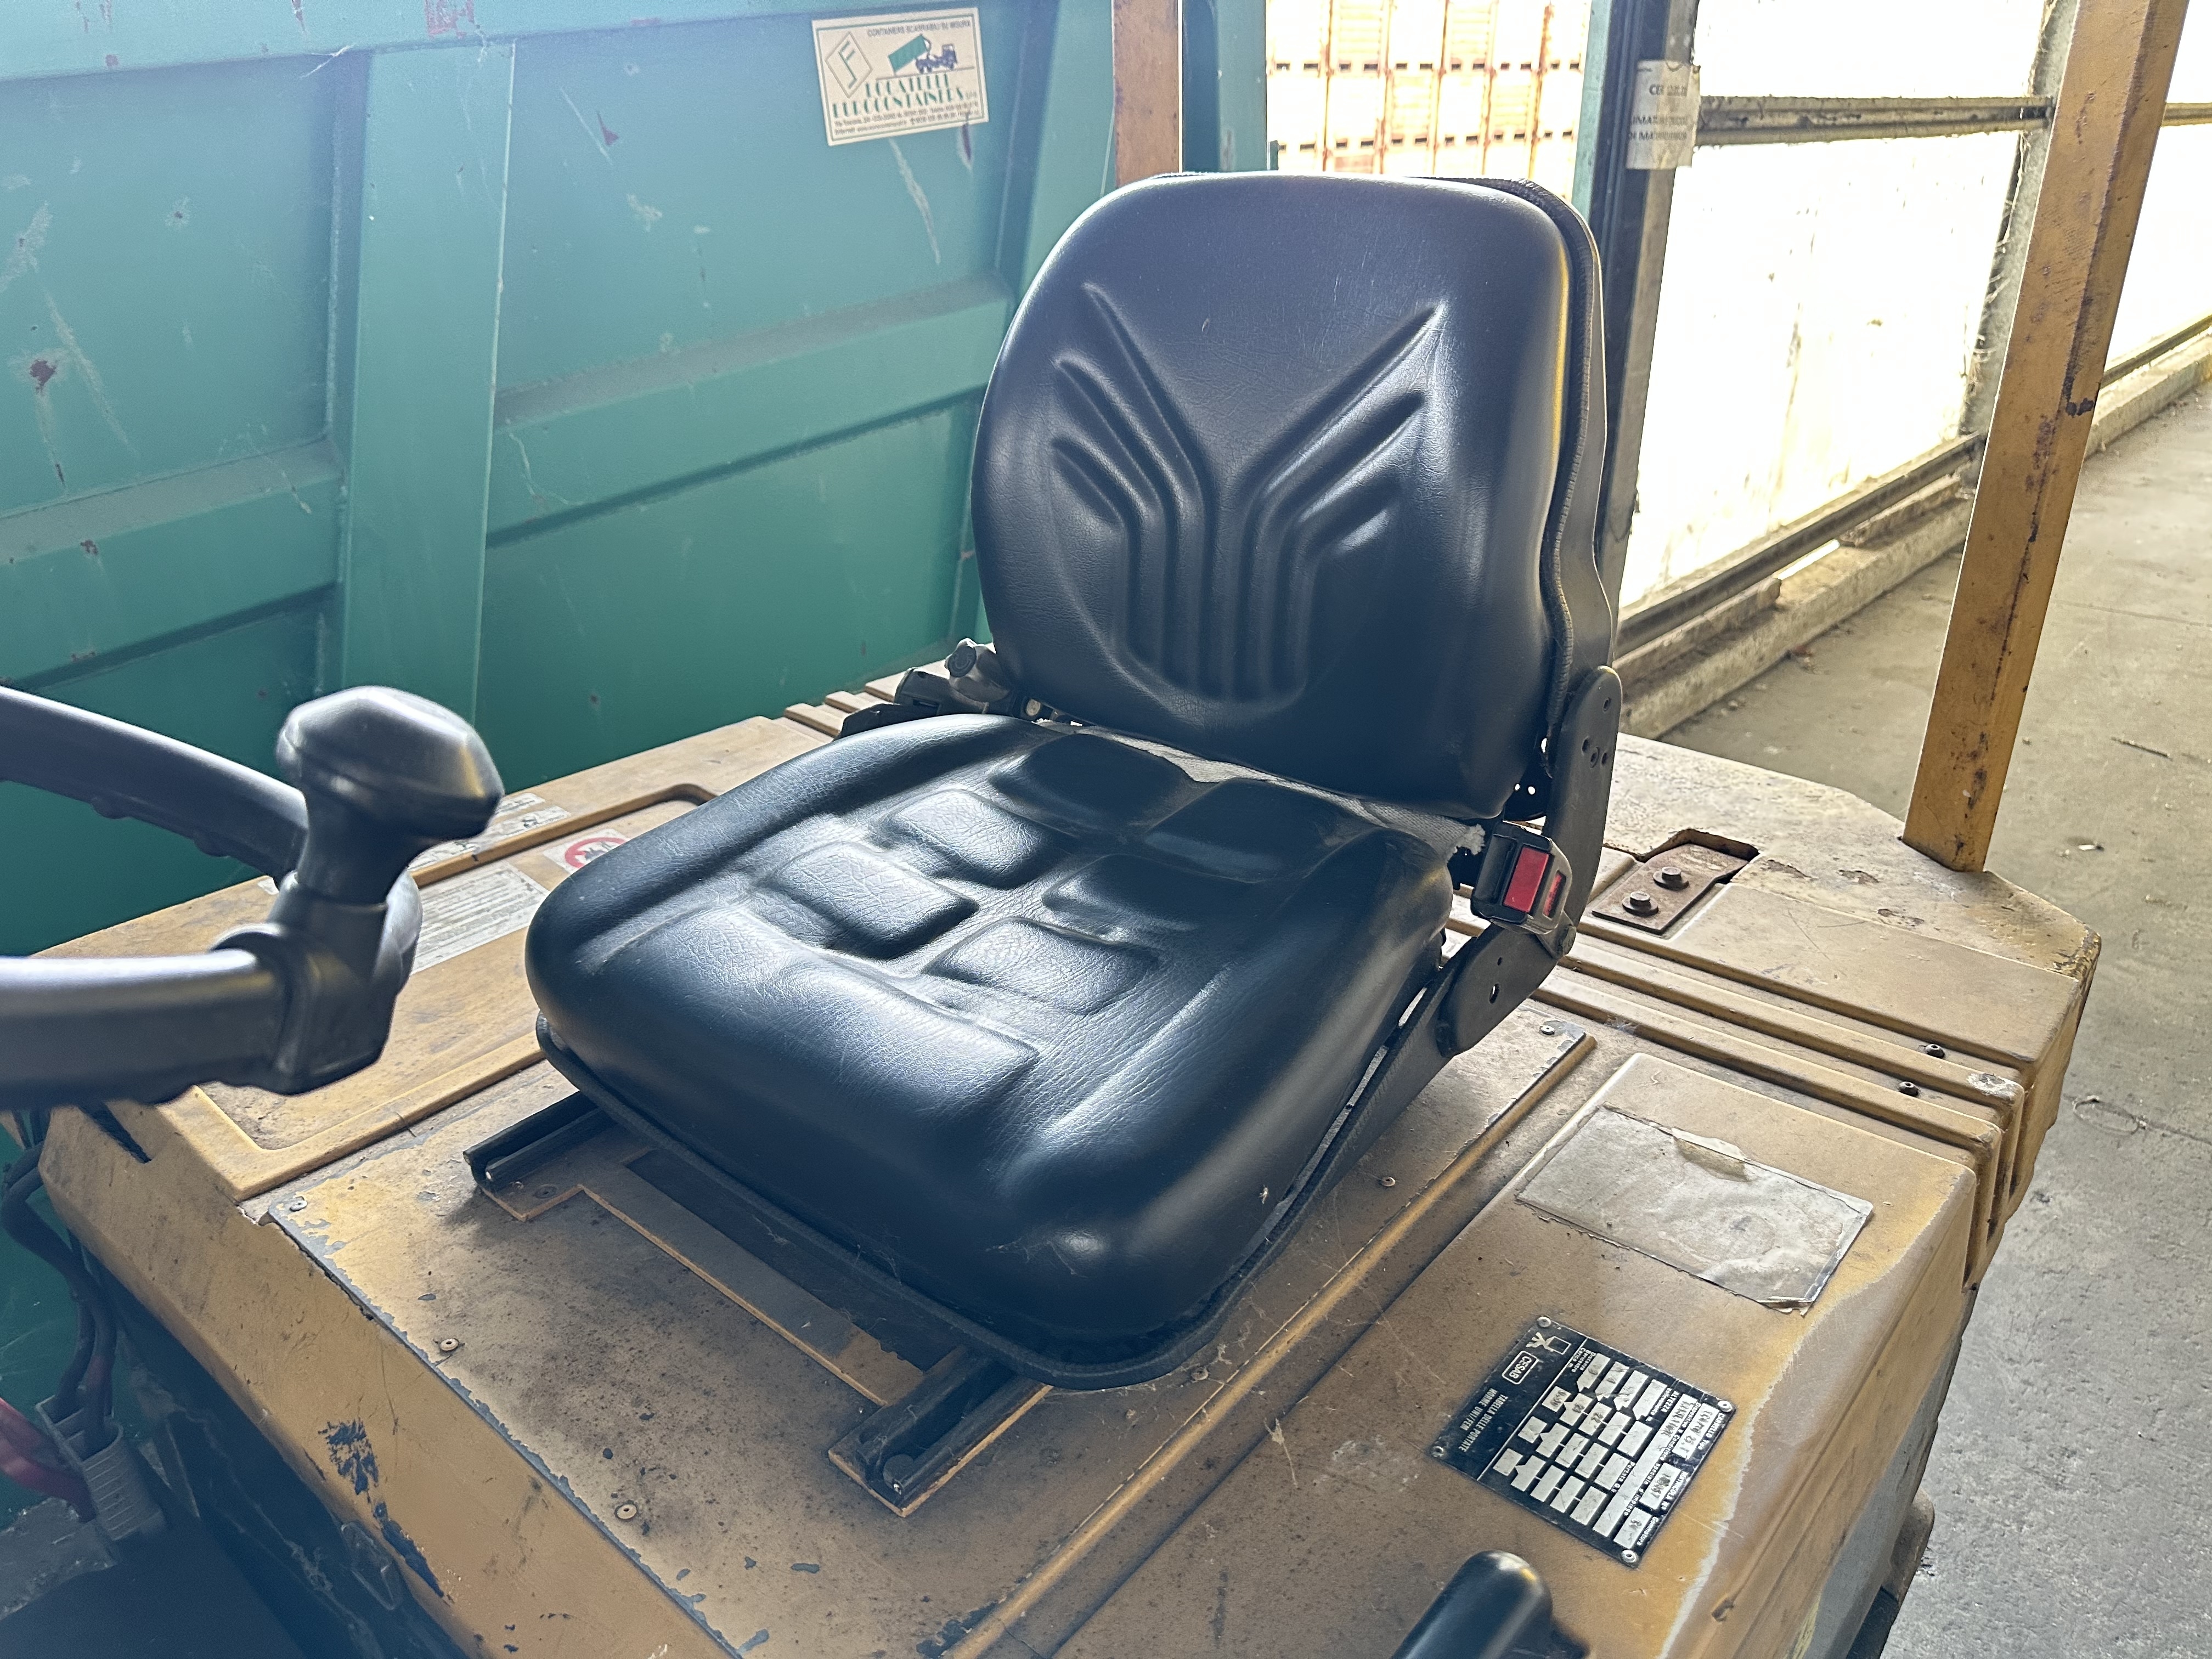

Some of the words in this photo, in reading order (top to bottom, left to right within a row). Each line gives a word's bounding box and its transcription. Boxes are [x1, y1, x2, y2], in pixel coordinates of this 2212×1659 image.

[1507, 1355, 1533, 1379] CESAB
[1570, 1349, 1591, 1373] Baricentro
[1578, 1351, 1596, 1371] Distanza
[1477, 1387, 1498, 1407] NORME
[1486, 1393, 1508, 1415] TABELLA
[1660, 1390, 1679, 1413] ALTEZZA
[1458, 1405, 1484, 1431] UNI/FEM
[1474, 1413, 1492, 1430] DELLE
[1705, 1412, 1725, 1438] CARRELLO
[1457, 1427, 1481, 1452] PORTATE
[1617, 1460, 1635, 1482] Portata
[1642, 1462, 1661, 1485] speciale
[1664, 1470, 1689, 1501] MATRICOLA
